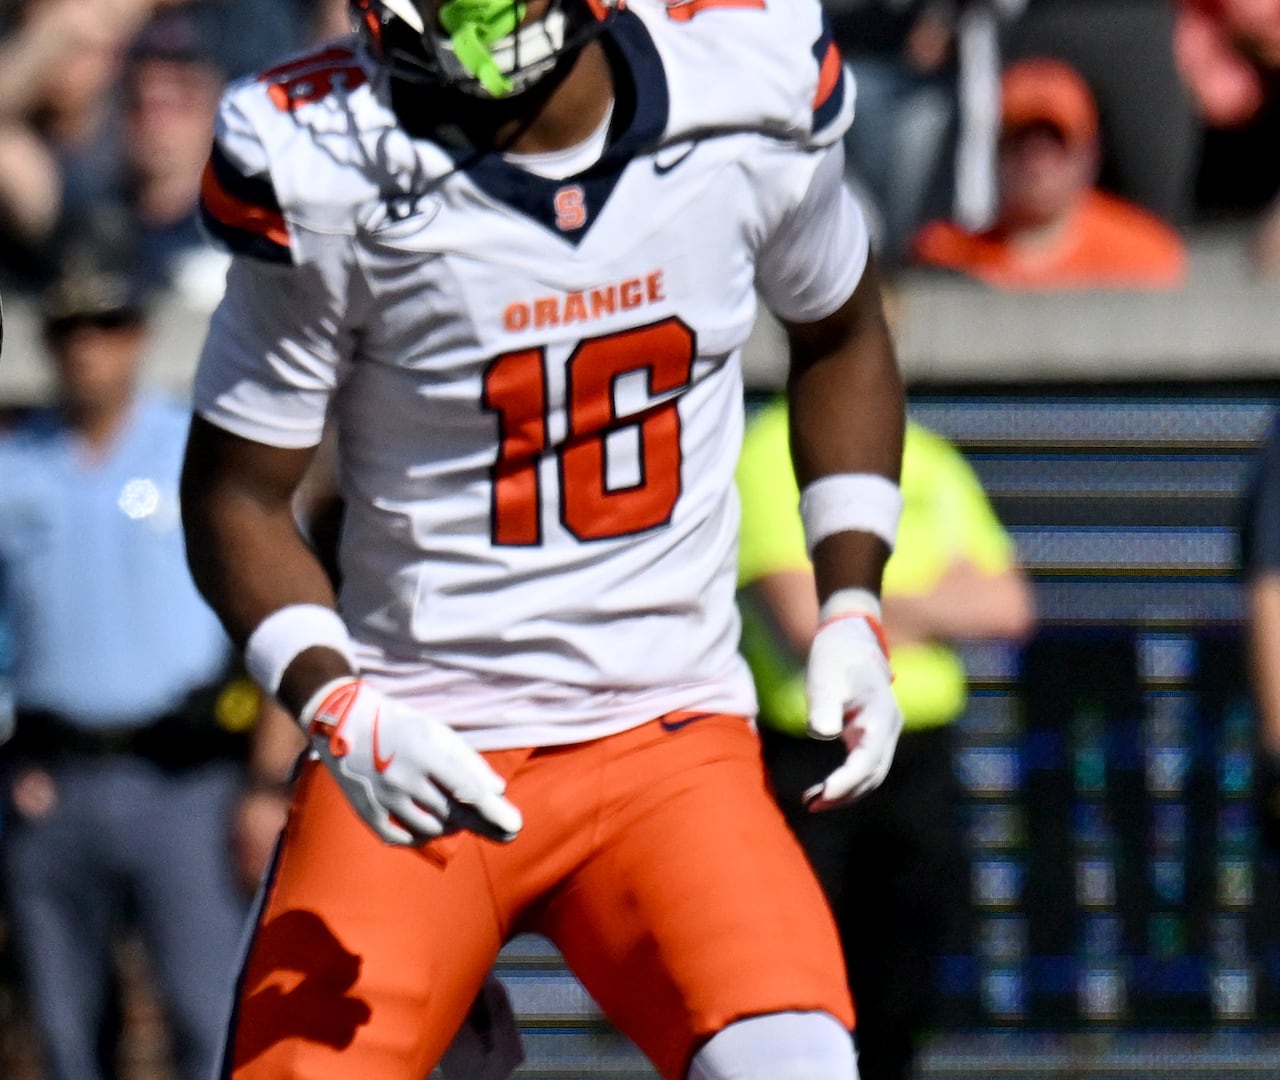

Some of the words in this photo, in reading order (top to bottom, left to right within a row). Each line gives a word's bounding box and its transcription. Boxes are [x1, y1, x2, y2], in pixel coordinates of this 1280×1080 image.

[554, 184, 588, 231] S
[503, 268, 667, 333] ORANGE
[481, 315, 697, 547] 16
